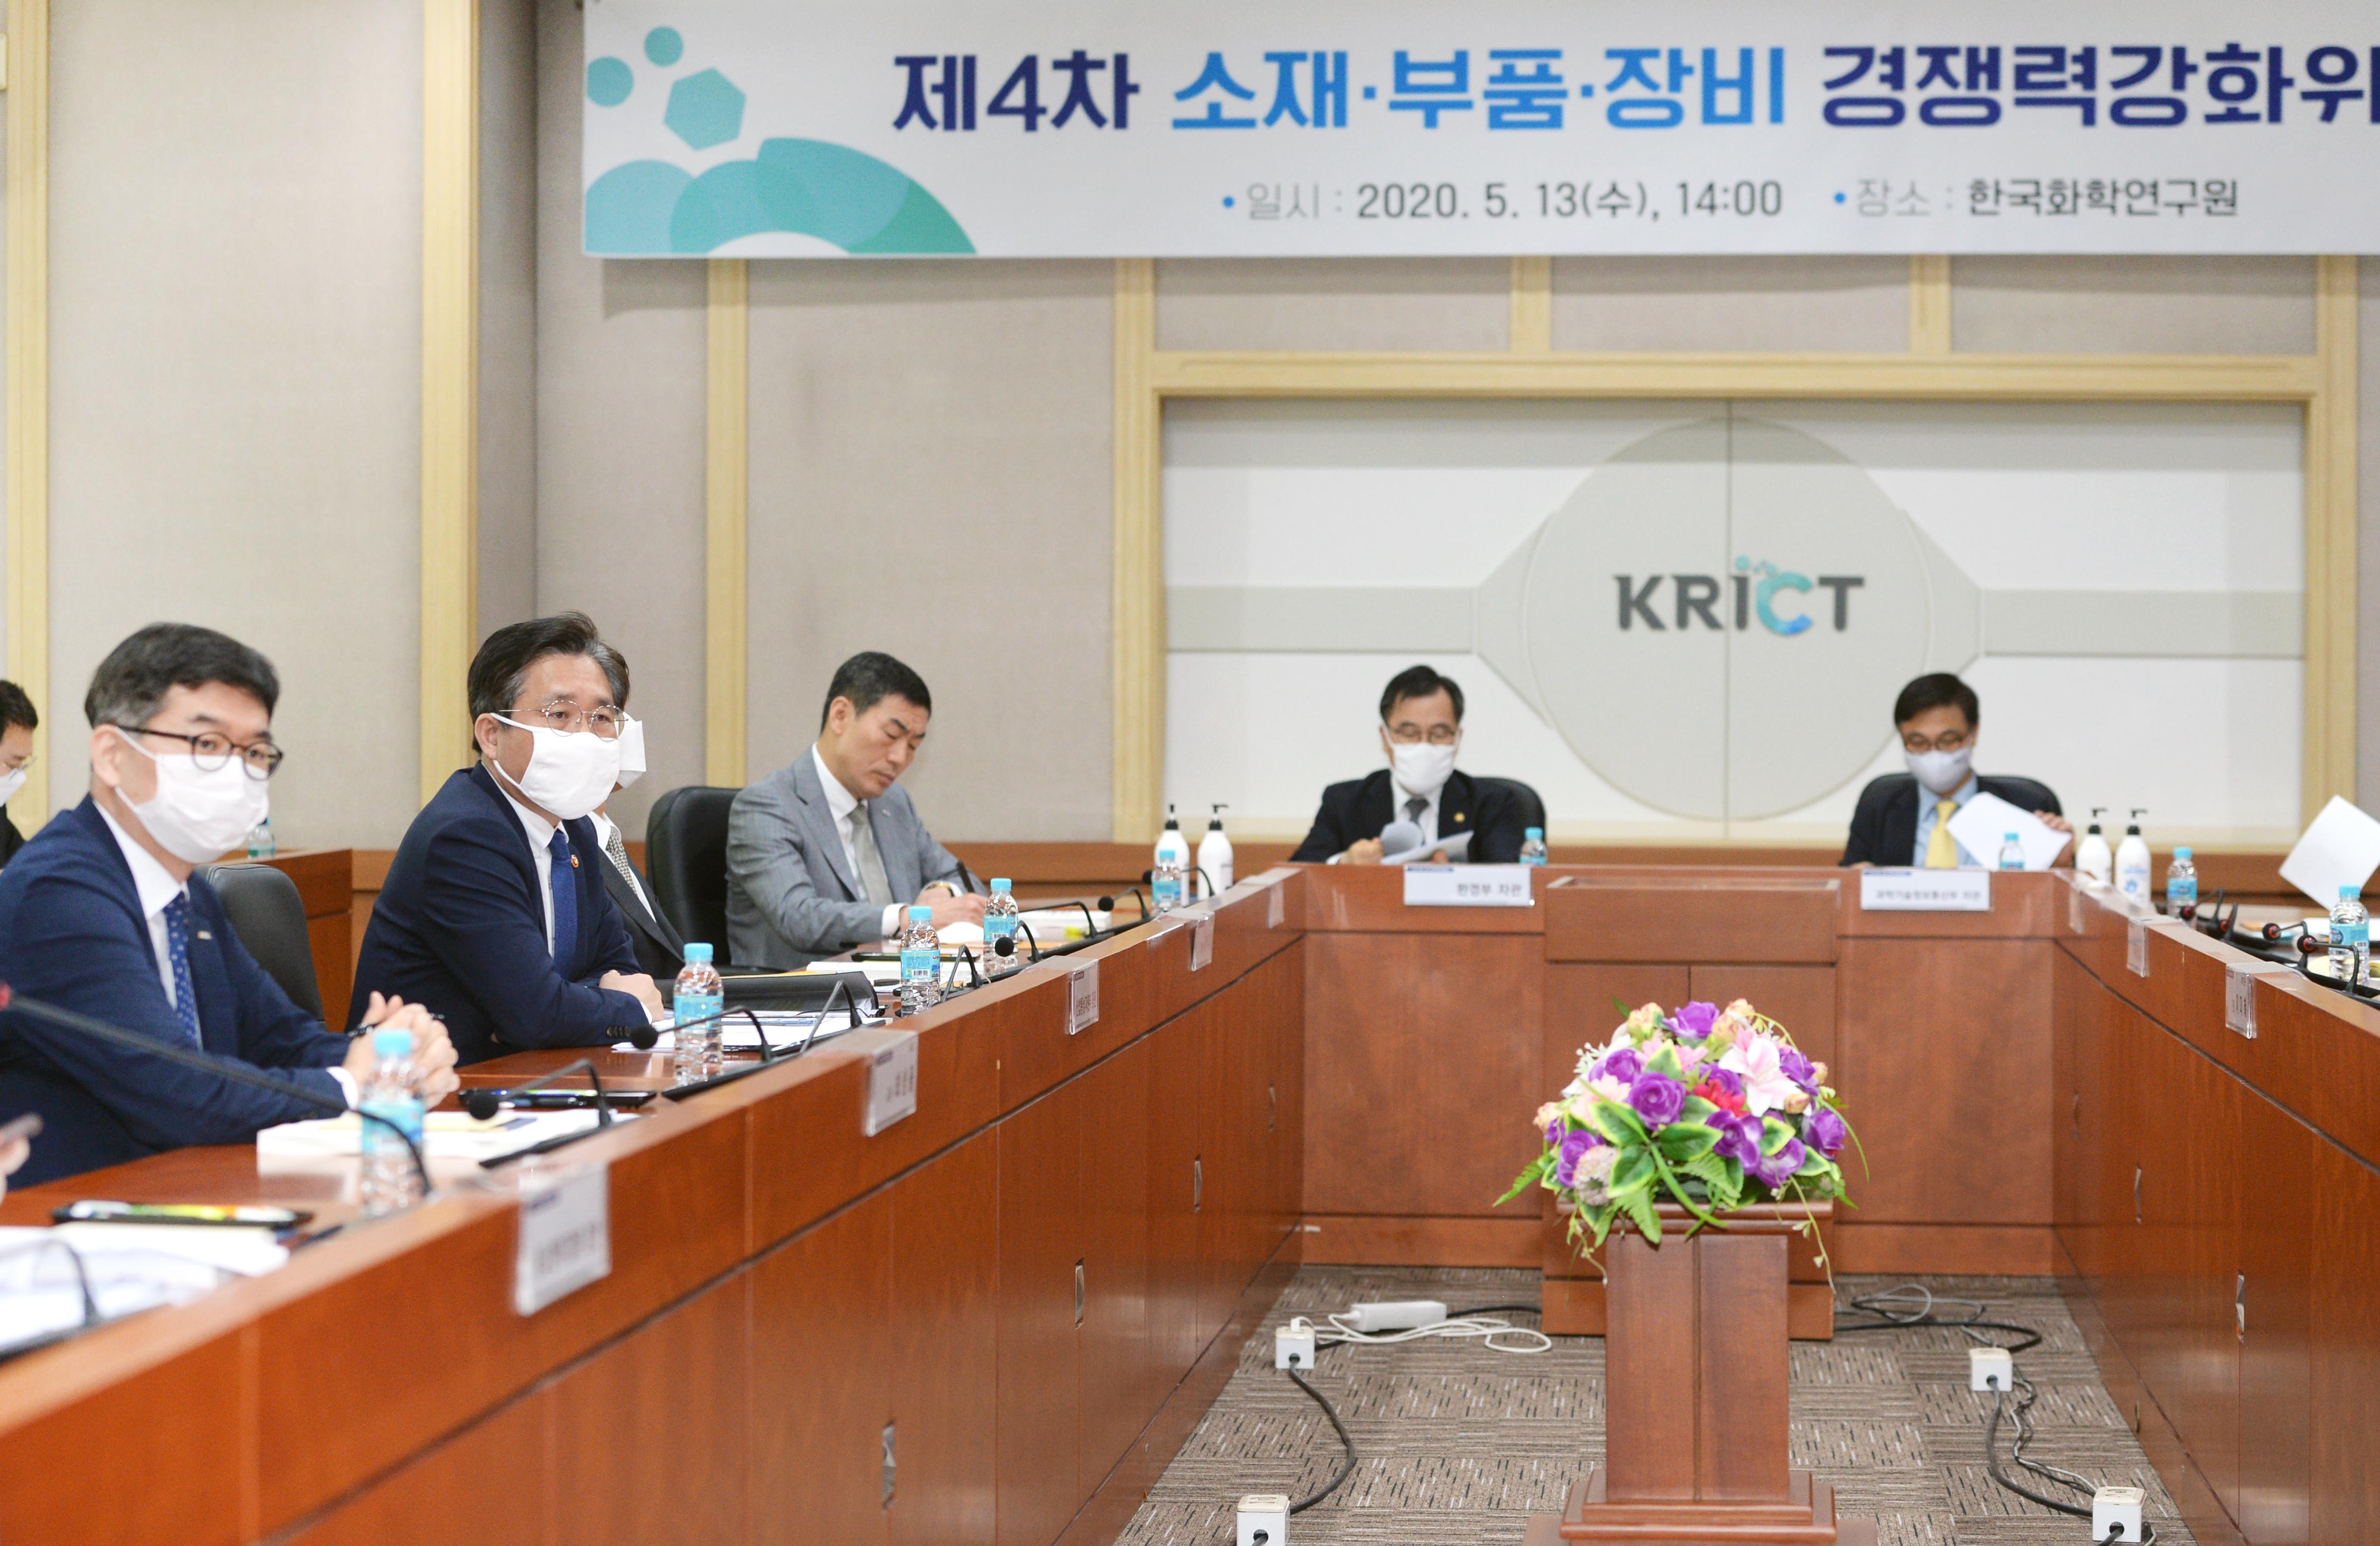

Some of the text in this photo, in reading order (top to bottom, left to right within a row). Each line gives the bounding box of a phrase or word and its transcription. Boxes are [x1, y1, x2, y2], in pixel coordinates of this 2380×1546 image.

[892, 49, 1141, 133] 제4차
[1821, 42, 2380, 128] 경쟁력강화위
[1247, 183, 1319, 220] 일시
[1357, 182, 1469, 219] 2020.
[1485, 182, 1518, 219] 5.
[1537, 181, 1660, 221] 13(수),
[1678, 180, 1783, 216] 14:00
[1858, 179, 1930, 217] 장소
[1968, 178, 2237, 217] 한국화학연구원
